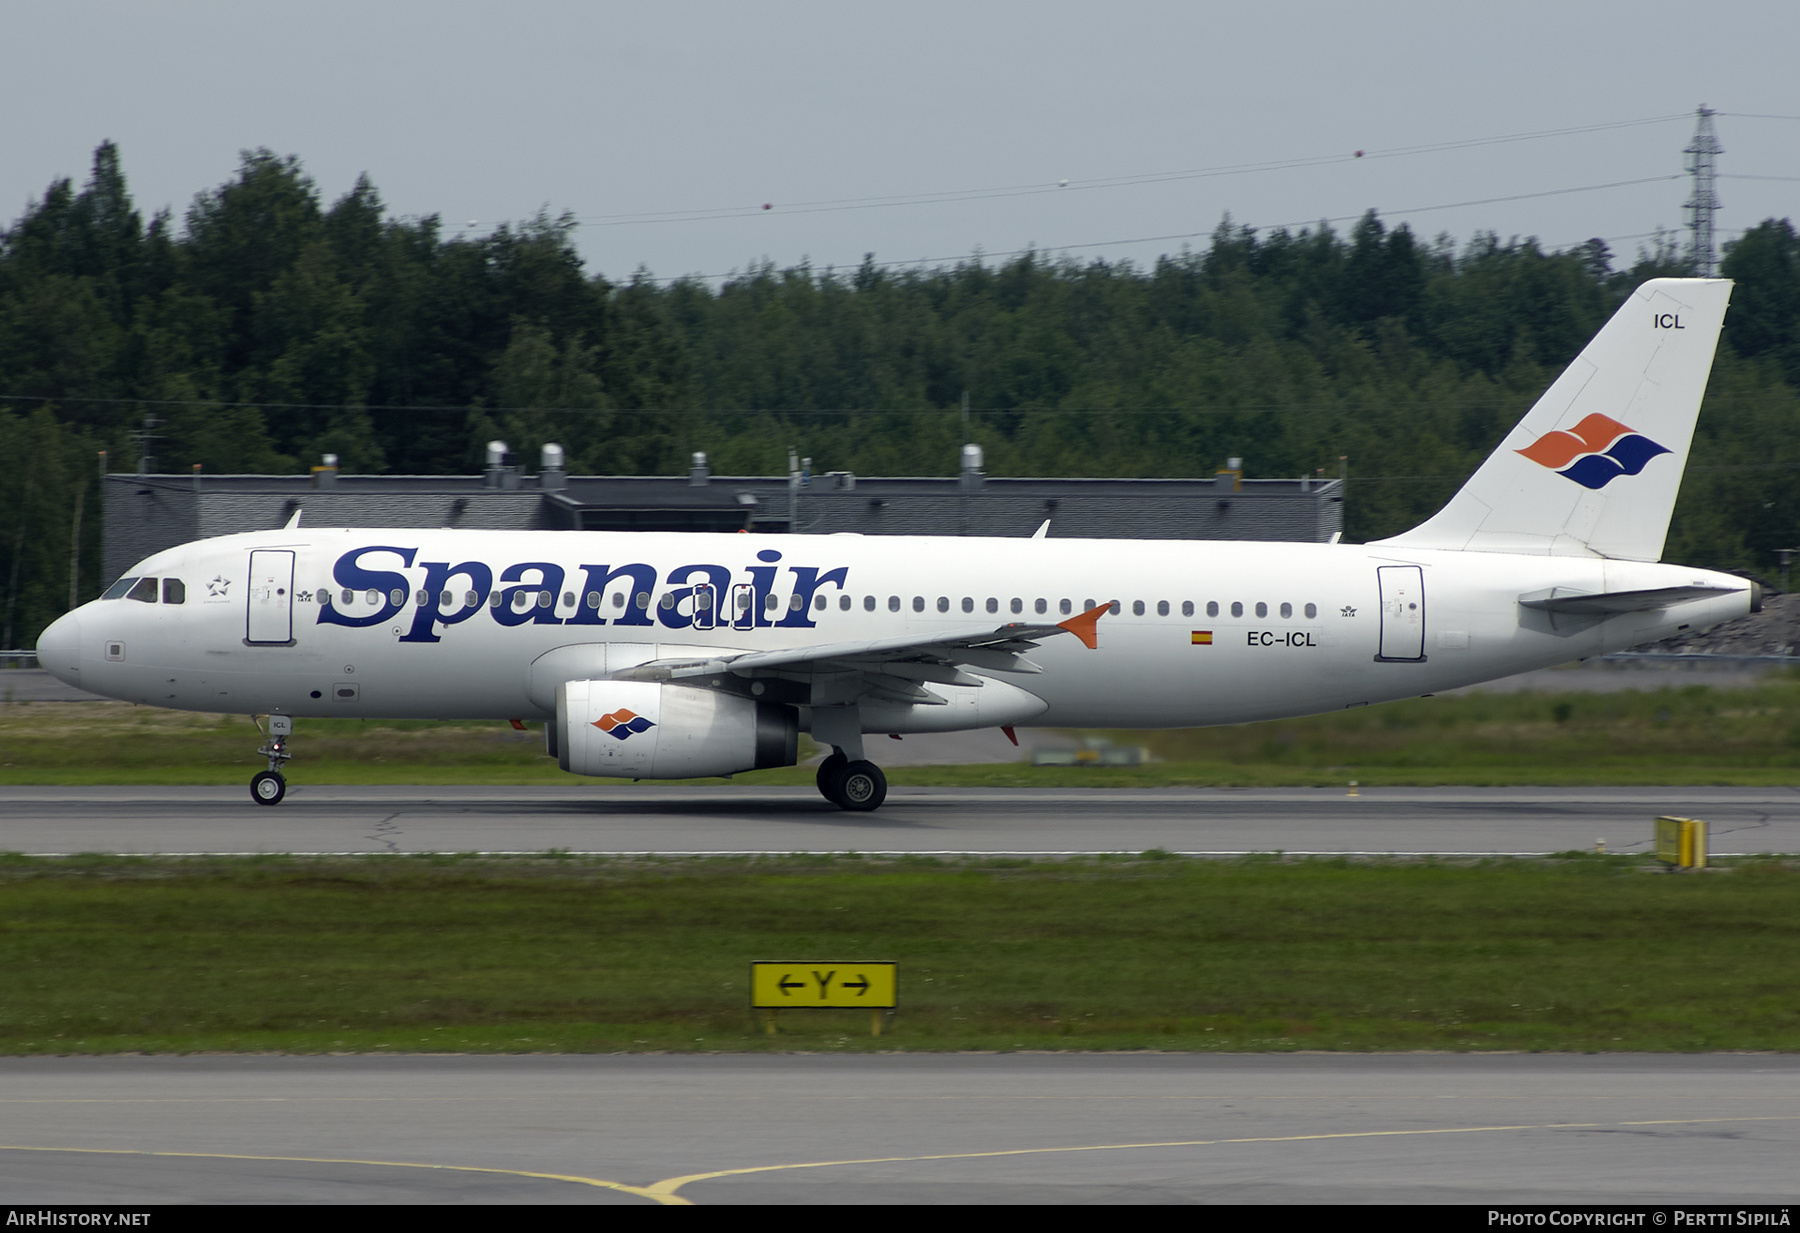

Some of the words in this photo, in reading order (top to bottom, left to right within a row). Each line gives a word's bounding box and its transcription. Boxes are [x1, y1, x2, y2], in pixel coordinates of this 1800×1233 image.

[1654, 313, 1686, 329] ICL
[316, 546, 849, 642] Spanair
[1247, 631, 1317, 647] EC-ICL
[273, 721, 286, 729] ICL
[811, 970, 837, 1000] Y
